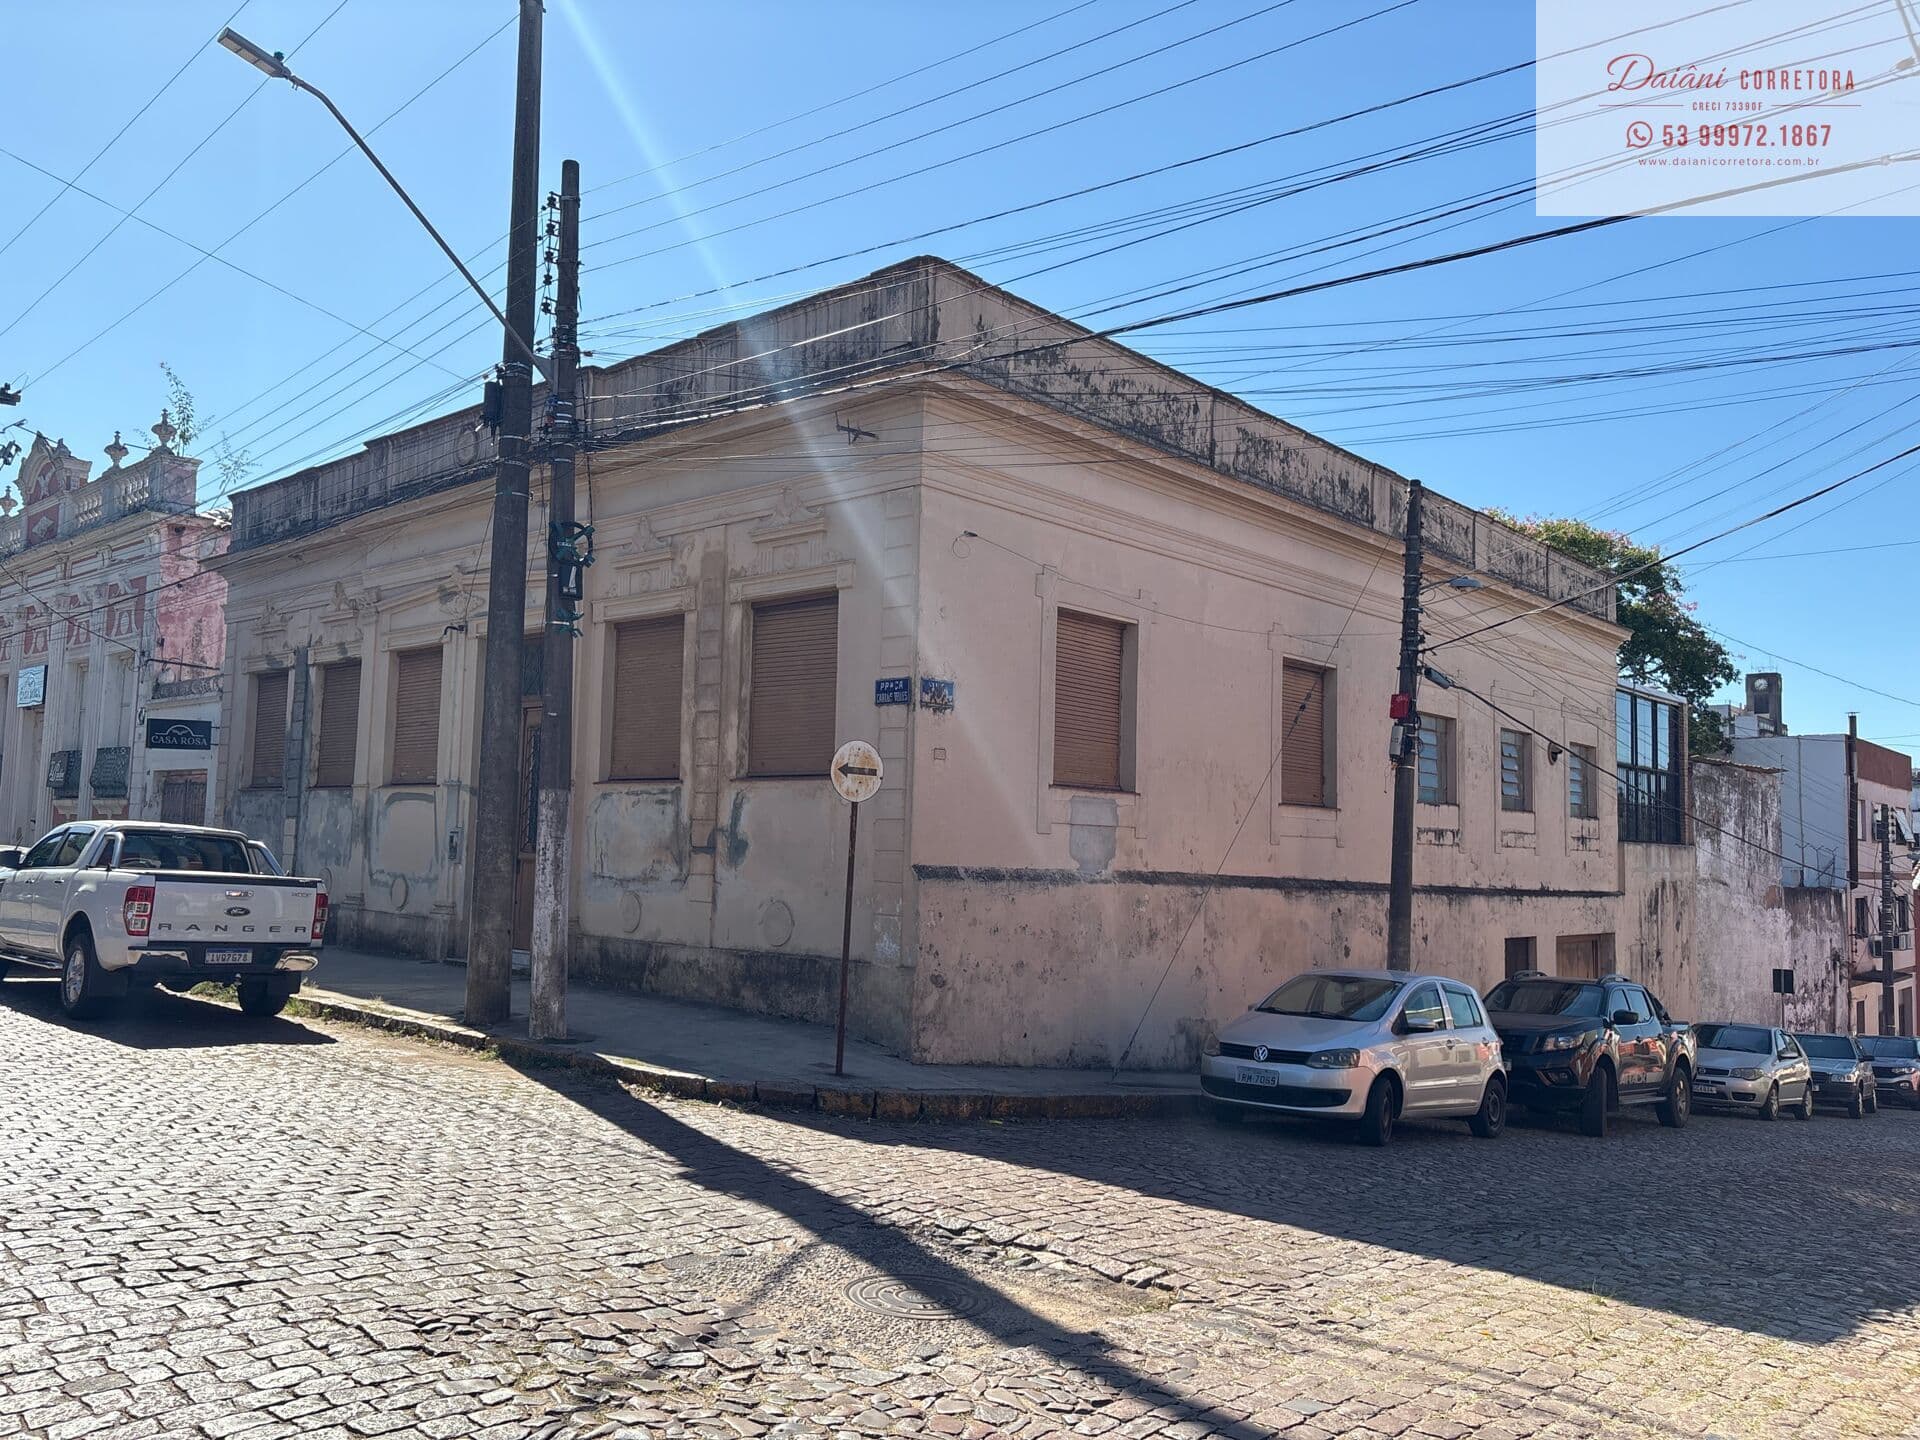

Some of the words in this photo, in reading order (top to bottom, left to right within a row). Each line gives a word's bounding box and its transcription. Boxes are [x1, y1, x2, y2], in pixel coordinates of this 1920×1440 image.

[151, 735, 178, 744] CASA
[180, 736, 208, 746] ROSA
[158, 923, 307, 933] RANGER
